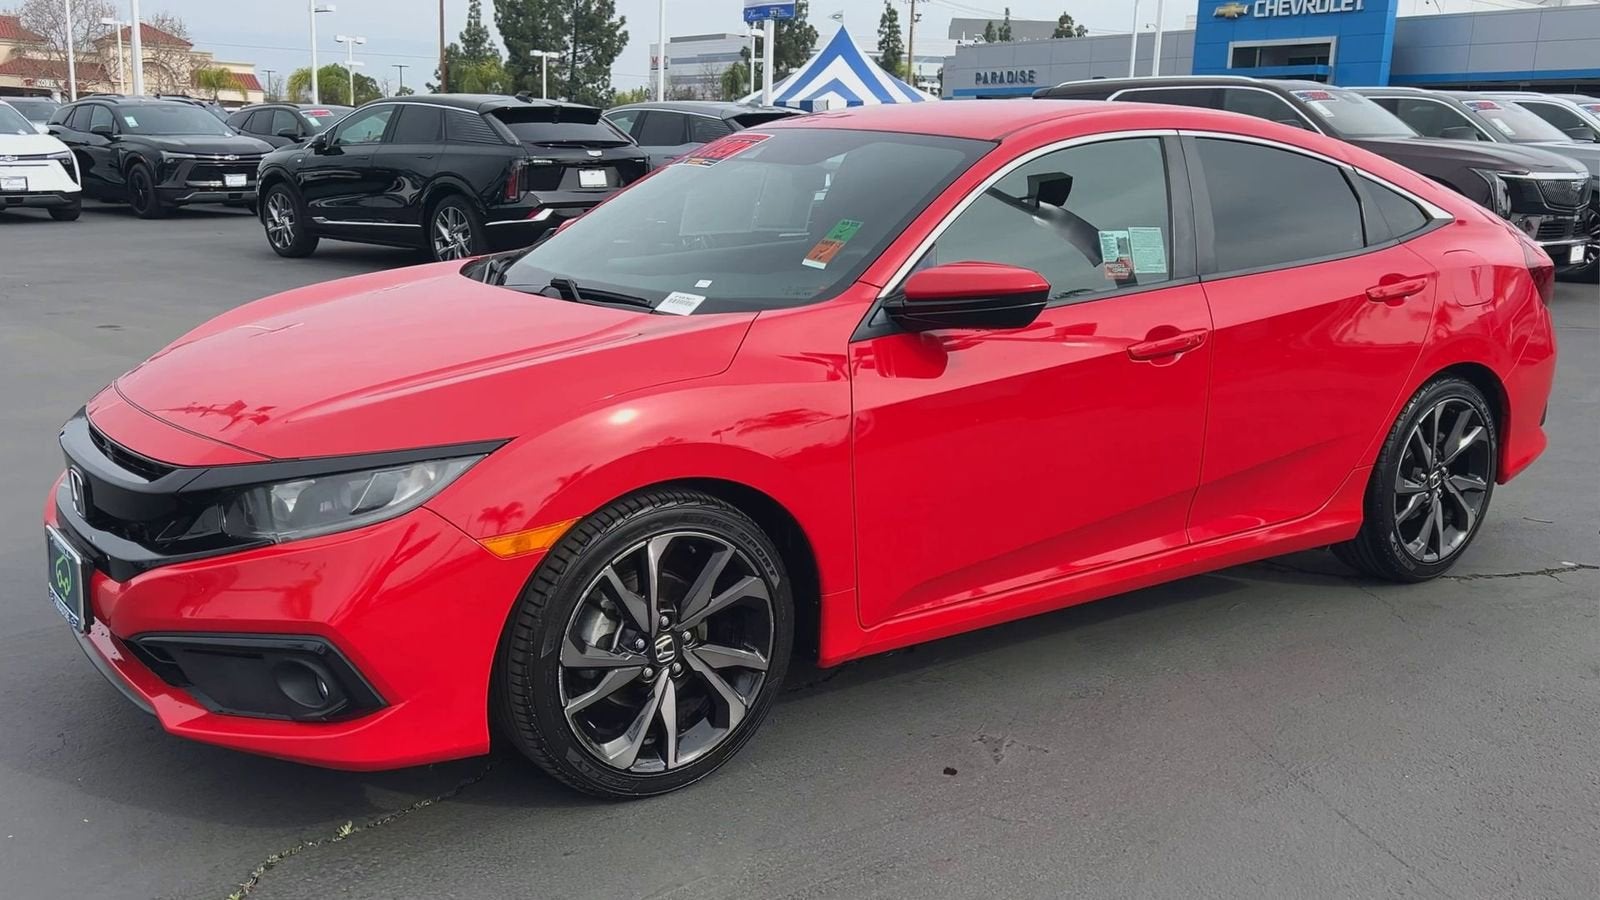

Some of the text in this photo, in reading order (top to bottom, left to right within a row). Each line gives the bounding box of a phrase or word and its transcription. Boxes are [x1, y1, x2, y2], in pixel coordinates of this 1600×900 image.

[1253, 0, 1363, 18] CHEVROLET
[975, 70, 1036, 85] PARADISE
[737, 532, 778, 578] SPORT
